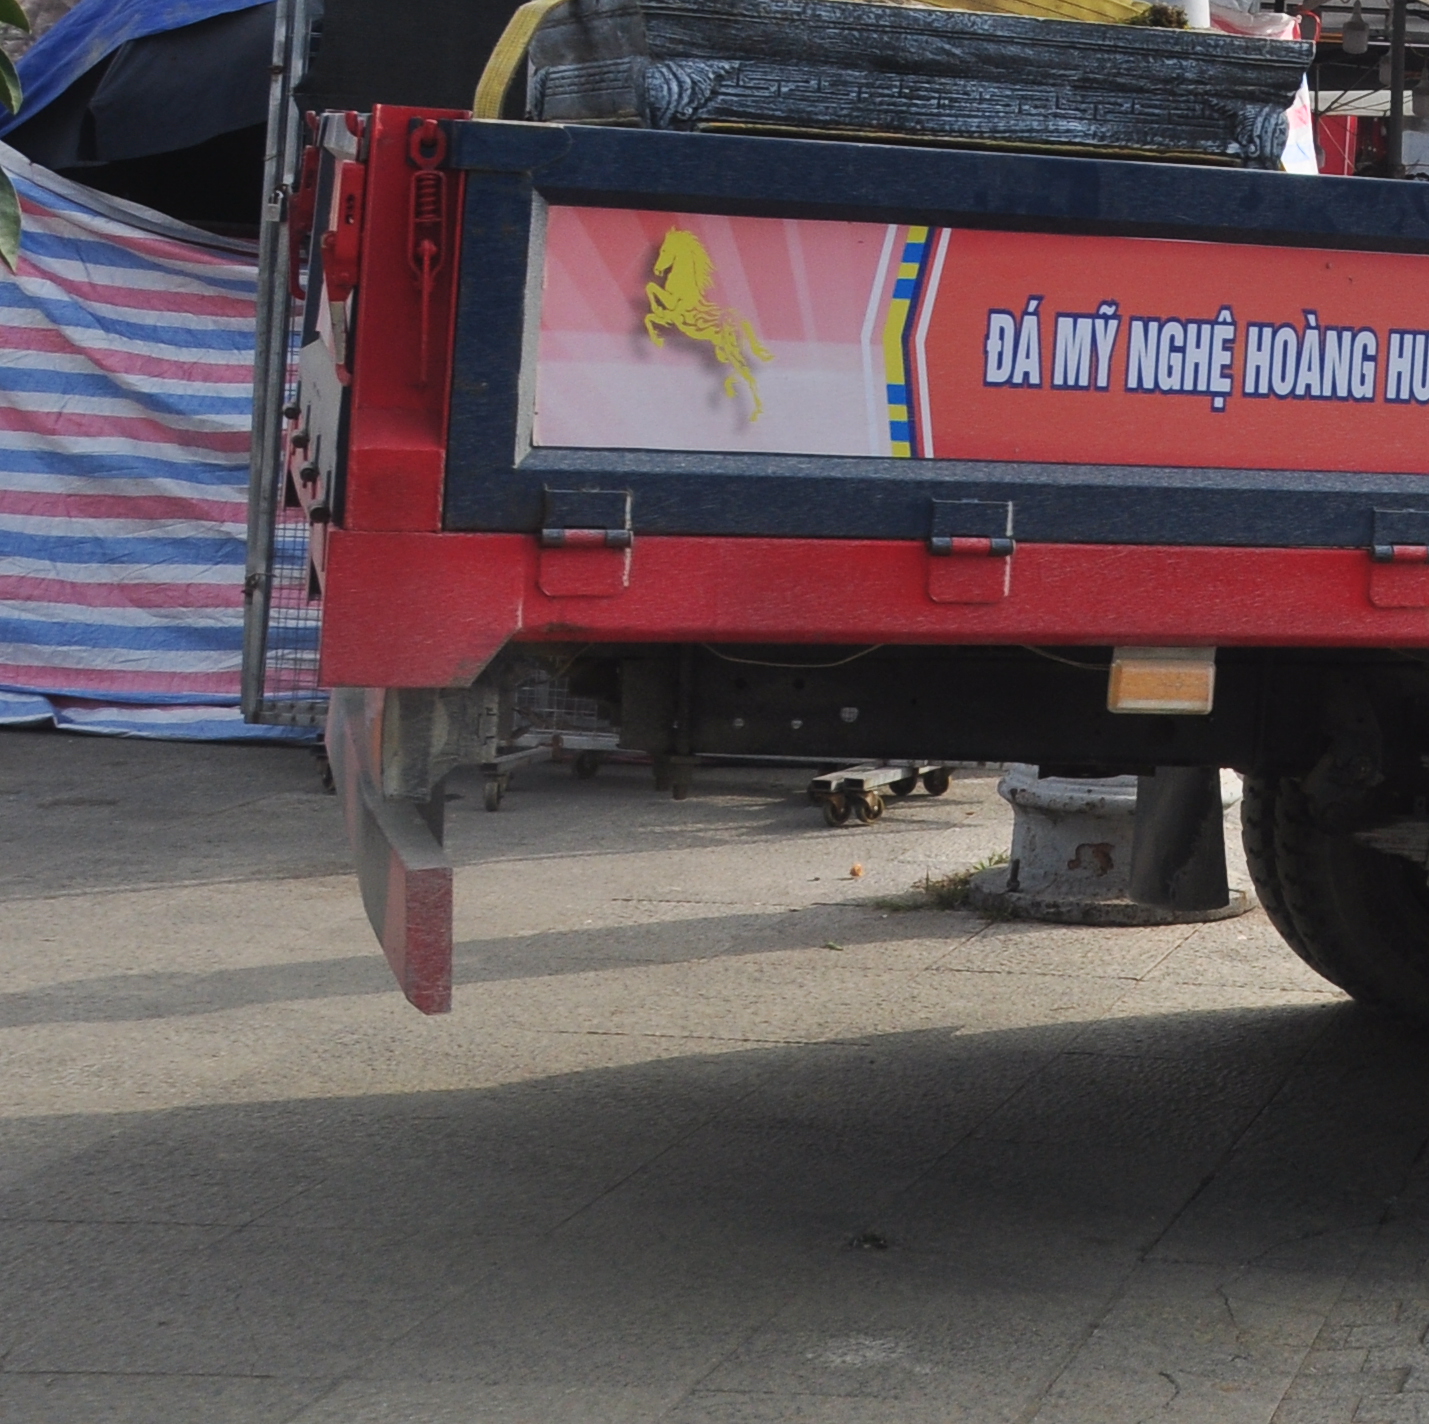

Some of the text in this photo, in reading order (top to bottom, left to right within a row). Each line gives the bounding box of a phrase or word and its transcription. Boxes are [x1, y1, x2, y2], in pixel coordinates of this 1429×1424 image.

[986, 297, 1039, 387] ĐÁ
[1055, 301, 1120, 390] MỸ
[1127, 307, 1234, 411] NGHỆ
[1243, 310, 1378, 400] HOÀNG
